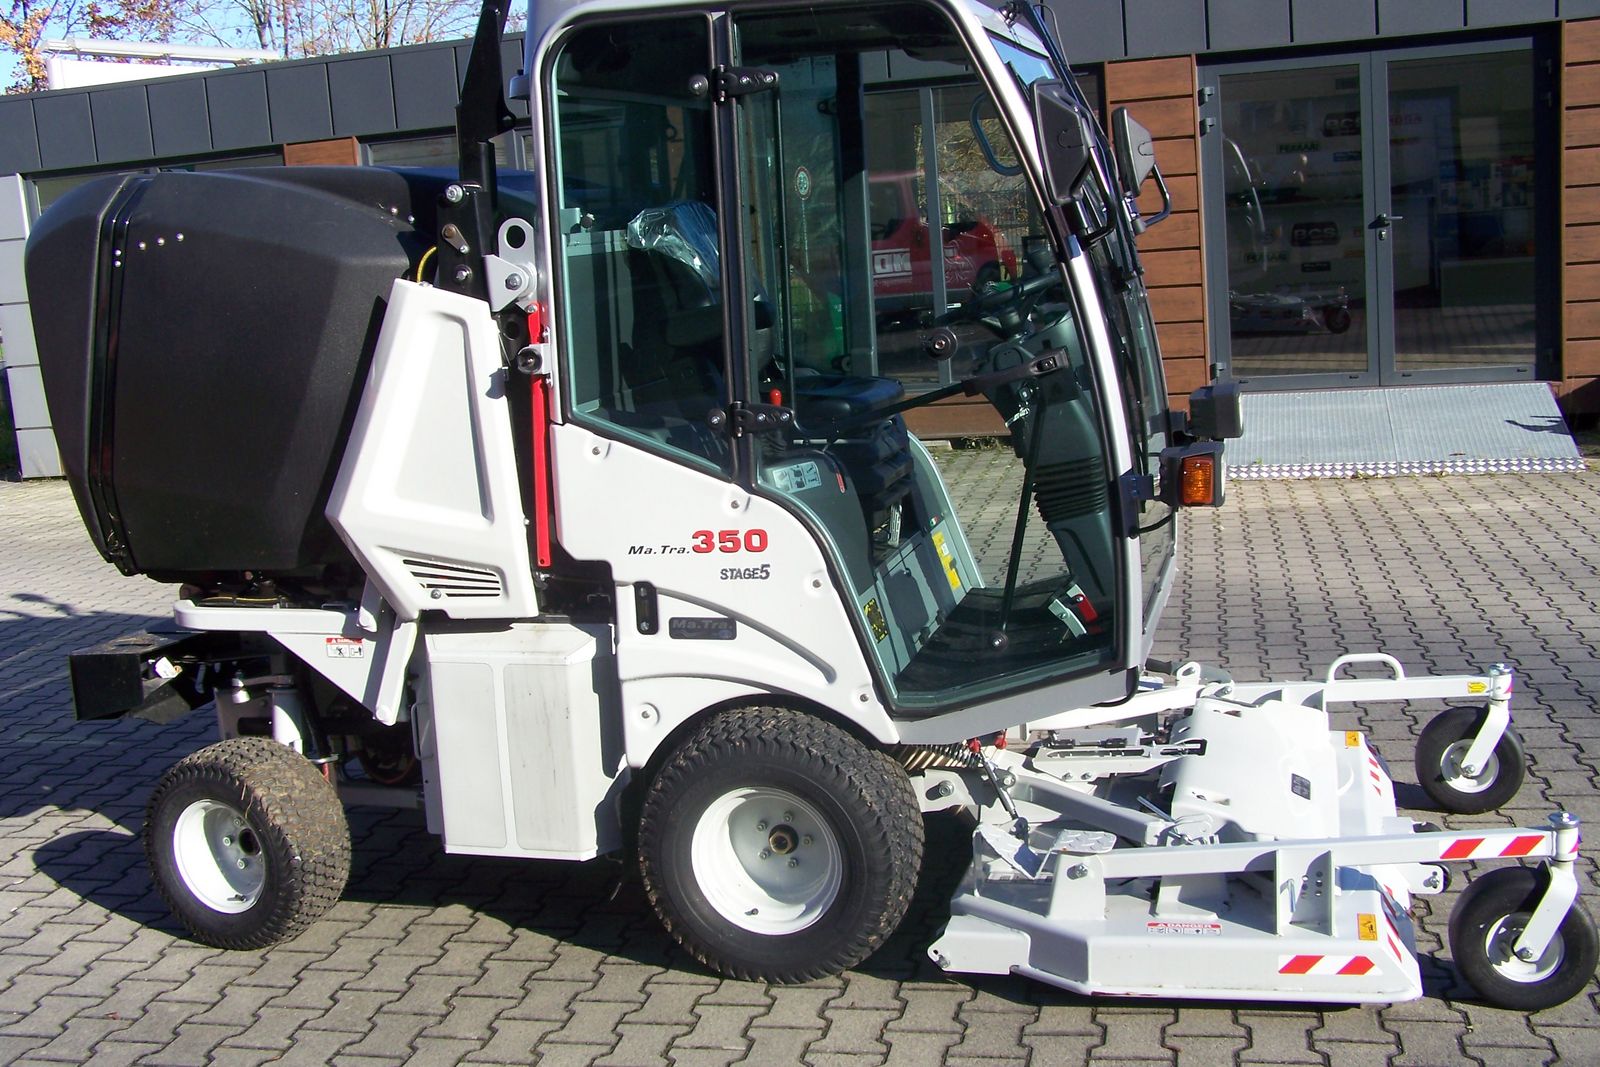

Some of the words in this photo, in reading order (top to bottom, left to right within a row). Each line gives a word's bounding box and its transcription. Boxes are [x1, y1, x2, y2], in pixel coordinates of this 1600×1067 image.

[1294, 227, 1335, 240] BCS
[628, 545, 690, 555] Ma.Tra.
[691, 529, 768, 553] 350
